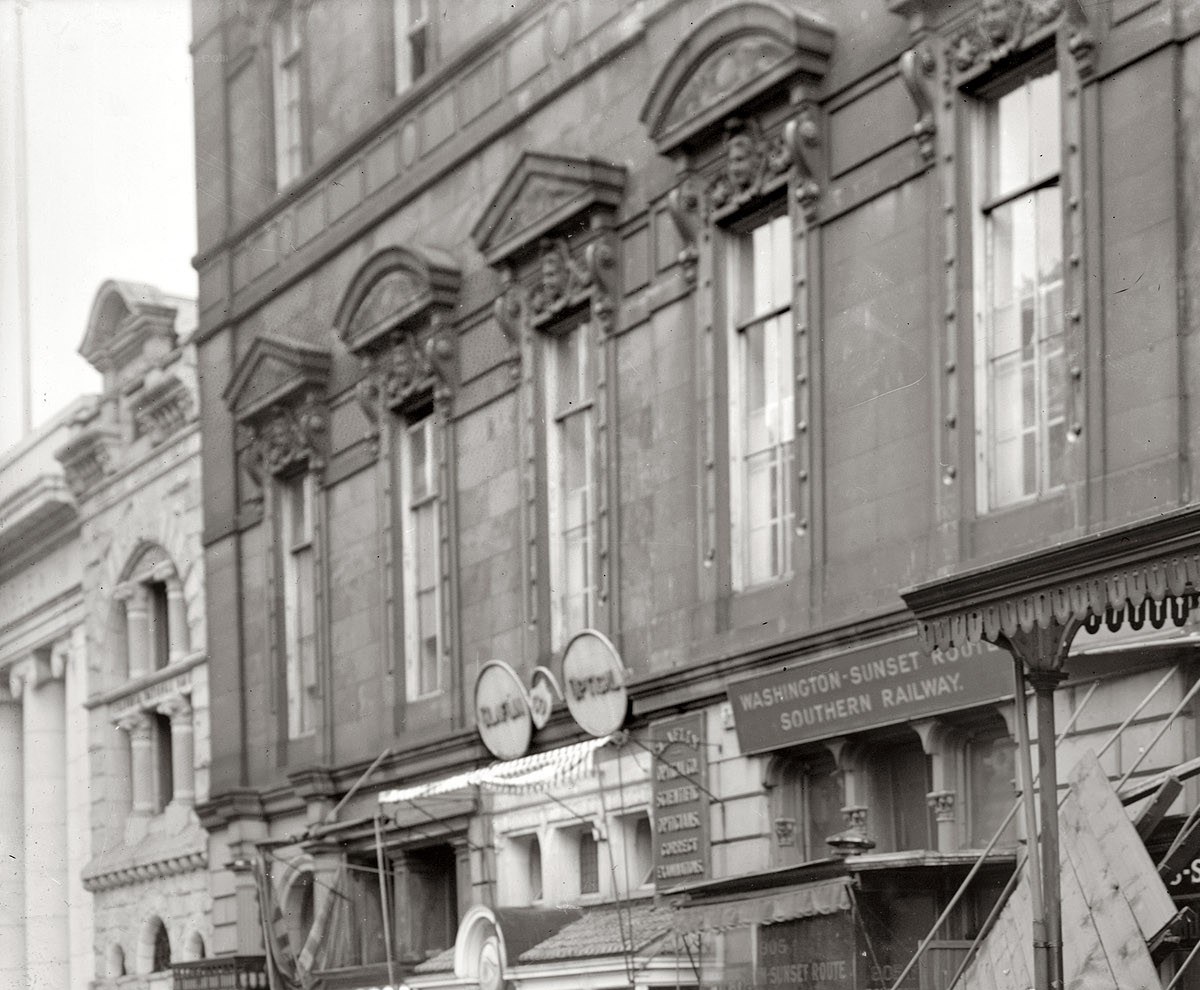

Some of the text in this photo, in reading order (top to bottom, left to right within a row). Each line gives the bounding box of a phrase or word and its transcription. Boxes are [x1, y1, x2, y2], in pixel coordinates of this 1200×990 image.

[740, 651, 919, 711] WASHINGTON-SUNSET
[780, 672, 963, 731] SOUTHERN RAILWAY.
[812, 960, 846, 982] ROUTE
